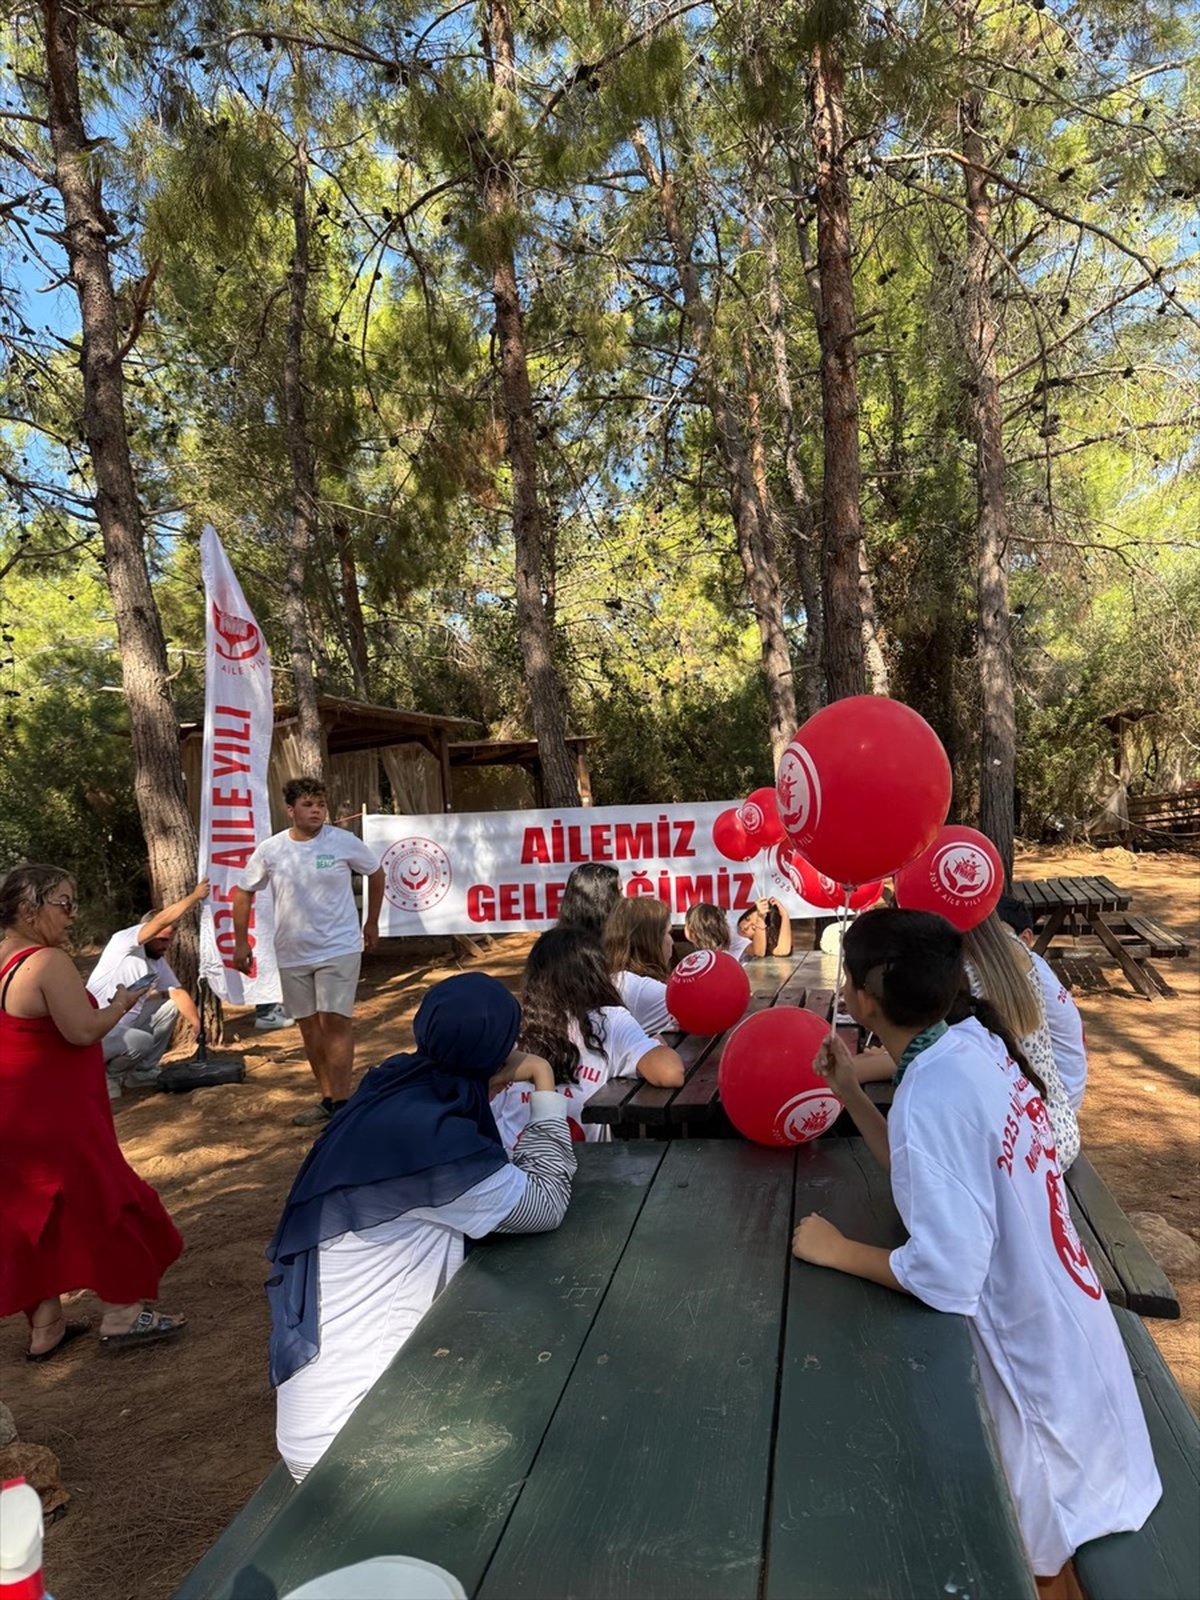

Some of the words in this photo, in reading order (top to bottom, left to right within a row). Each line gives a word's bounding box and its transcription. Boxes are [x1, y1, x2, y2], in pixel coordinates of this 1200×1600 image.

[212, 705, 252, 779] YILI
[520, 814, 697, 865] AİLEMİZ
[466, 866, 756, 924] GELEĞİMİZ
[575, 1064, 602, 1084] YILI
[996, 1113, 1020, 1178] 2025
